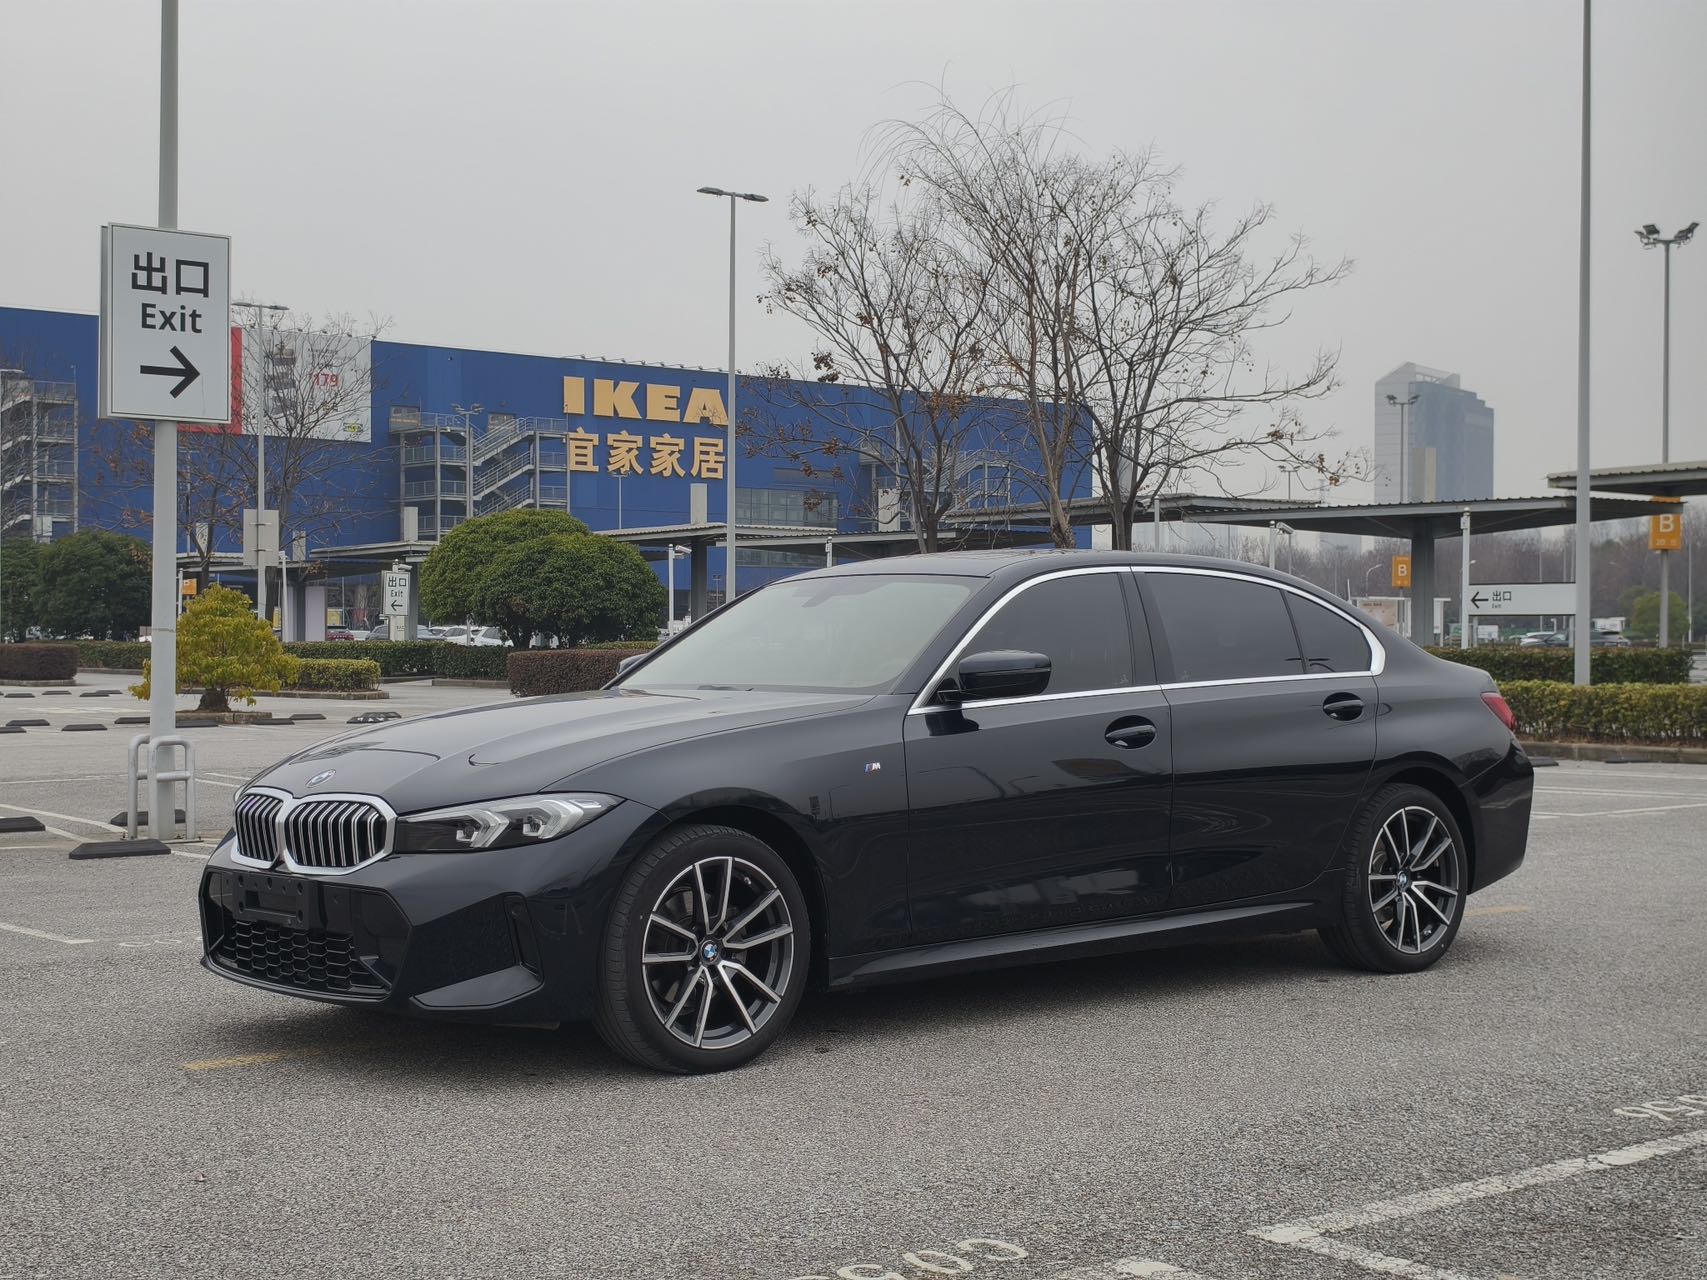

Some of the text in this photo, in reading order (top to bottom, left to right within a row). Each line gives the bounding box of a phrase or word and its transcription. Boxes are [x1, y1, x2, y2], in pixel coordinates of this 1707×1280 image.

[131, 251, 209, 298] 出口
[141, 302, 202, 334] Exit
[563, 376, 729, 426] IKEA
[567, 426, 726, 479] 宜家家居
[1659, 513, 1674, 532] B
[1398, 564, 1407, 577] B
[388, 576, 406, 588] 出口
[391, 589, 403, 598] Exit
[1492, 590, 1512, 602] 出口
